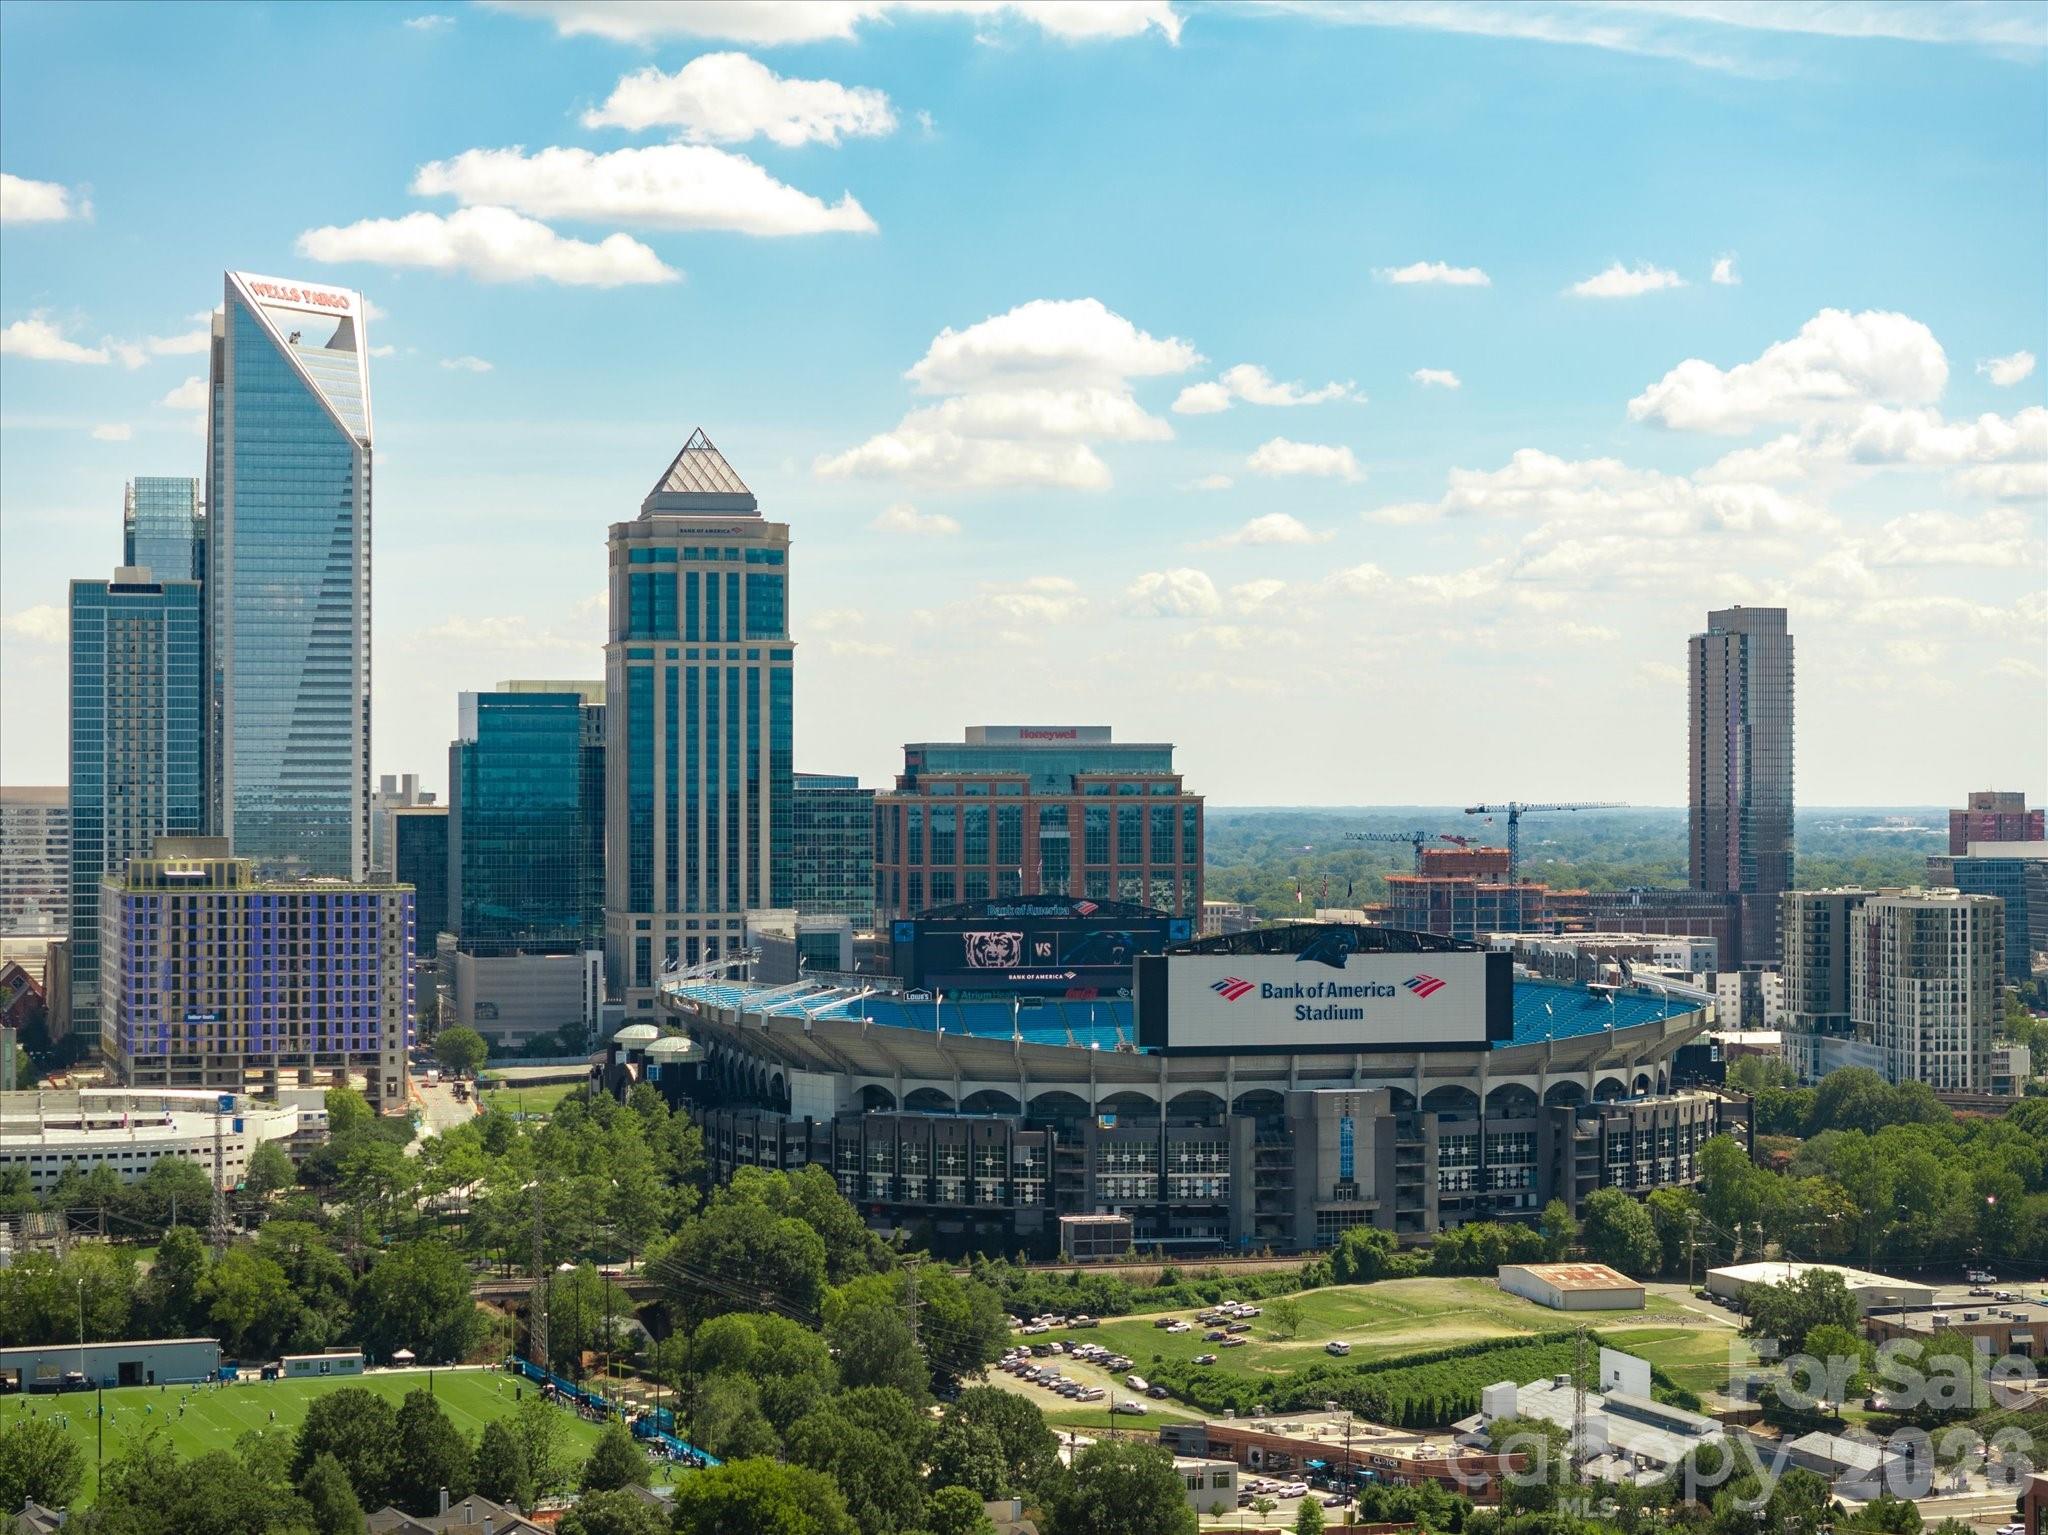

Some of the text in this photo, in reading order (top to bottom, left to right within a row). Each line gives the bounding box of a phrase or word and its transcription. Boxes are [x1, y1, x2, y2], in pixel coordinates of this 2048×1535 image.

[250, 282, 350, 309] WELLS FARGO
[1020, 728, 1076, 740] Honeywell
[987, 904, 1070, 916] Bank of America
[1035, 943, 1052, 957] VS
[961, 991, 992, 1000] Atrium
[1261, 981, 1396, 999] Bank of America
[1295, 1005, 1364, 1021] Stadium
